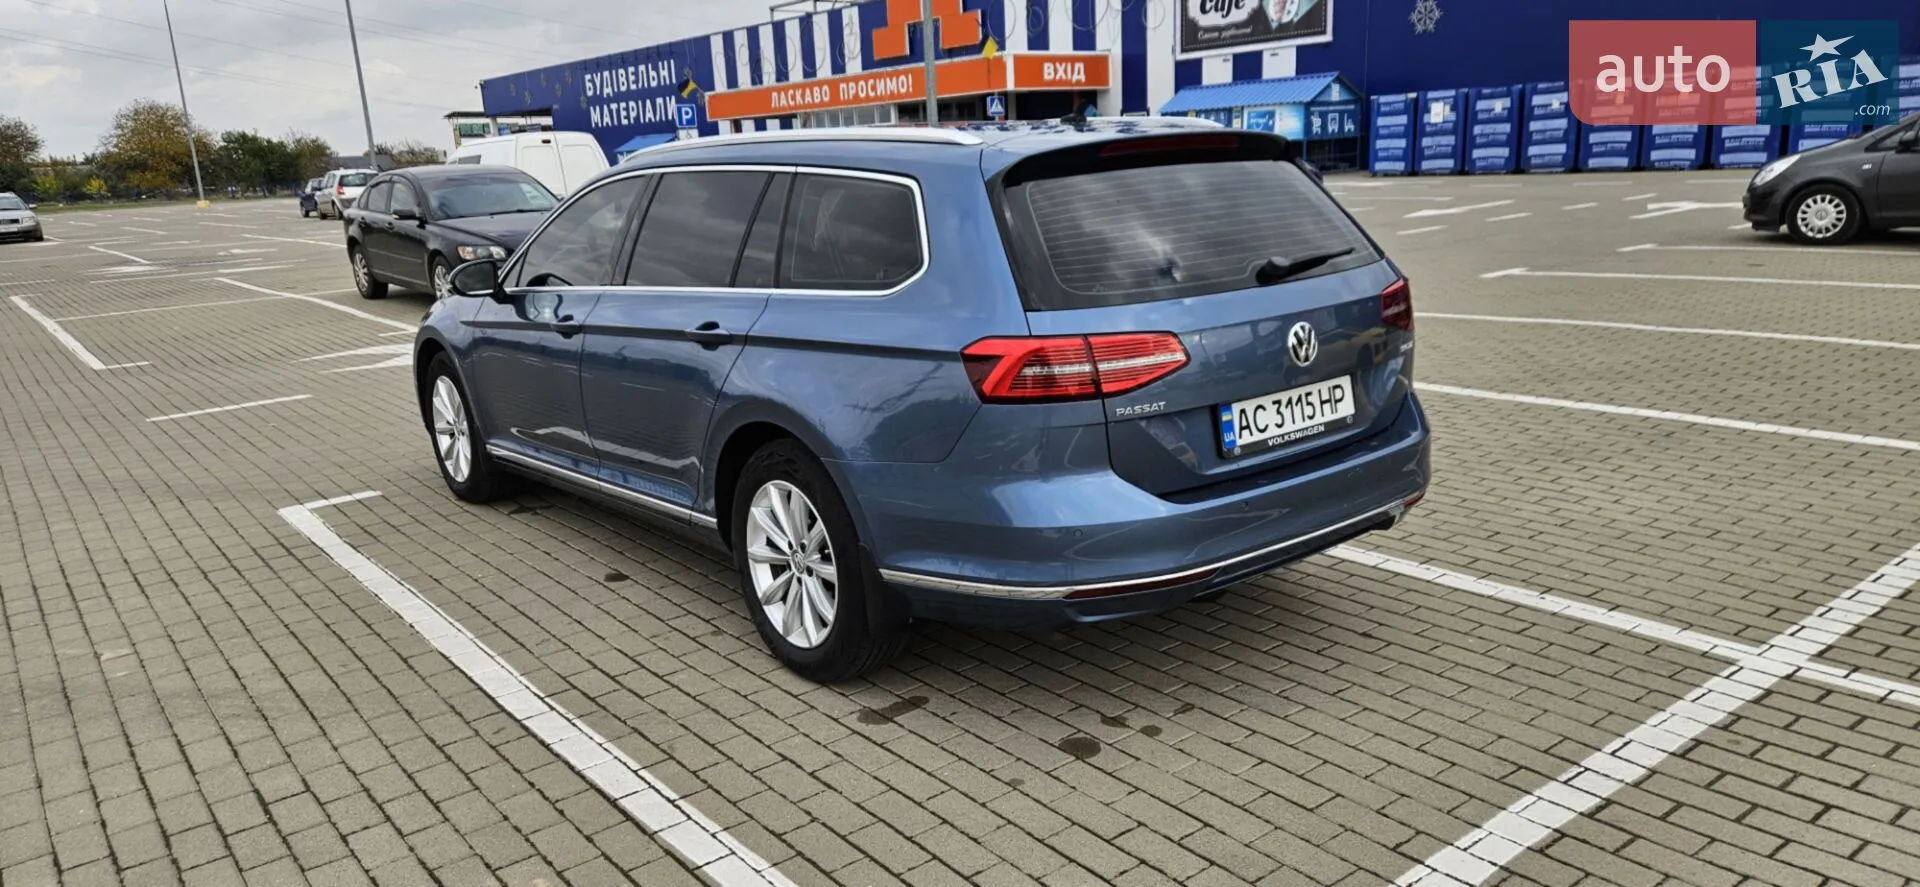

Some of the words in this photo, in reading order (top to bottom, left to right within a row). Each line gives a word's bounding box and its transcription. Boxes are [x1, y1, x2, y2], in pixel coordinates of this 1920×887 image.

[584, 58, 677, 98] БУДІВЕЛЬНІ
[1043, 61, 1086, 83] ВХІД
[771, 84, 831, 109] ЛАСКАВО
[839, 72, 913, 101] ПРОСИМО!
[589, 95, 677, 129] МАТЕРІАЛИ
[681, 106, 693, 126] P
[1115, 401, 1166, 417] PASSAT
[1238, 403, 1269, 439] AC
[1271, 390, 1317, 429] 3115
[1318, 383, 1345, 418] HP
[1223, 431, 1236, 443] UA
[1267, 424, 1326, 447] VOLKSWAGEN
